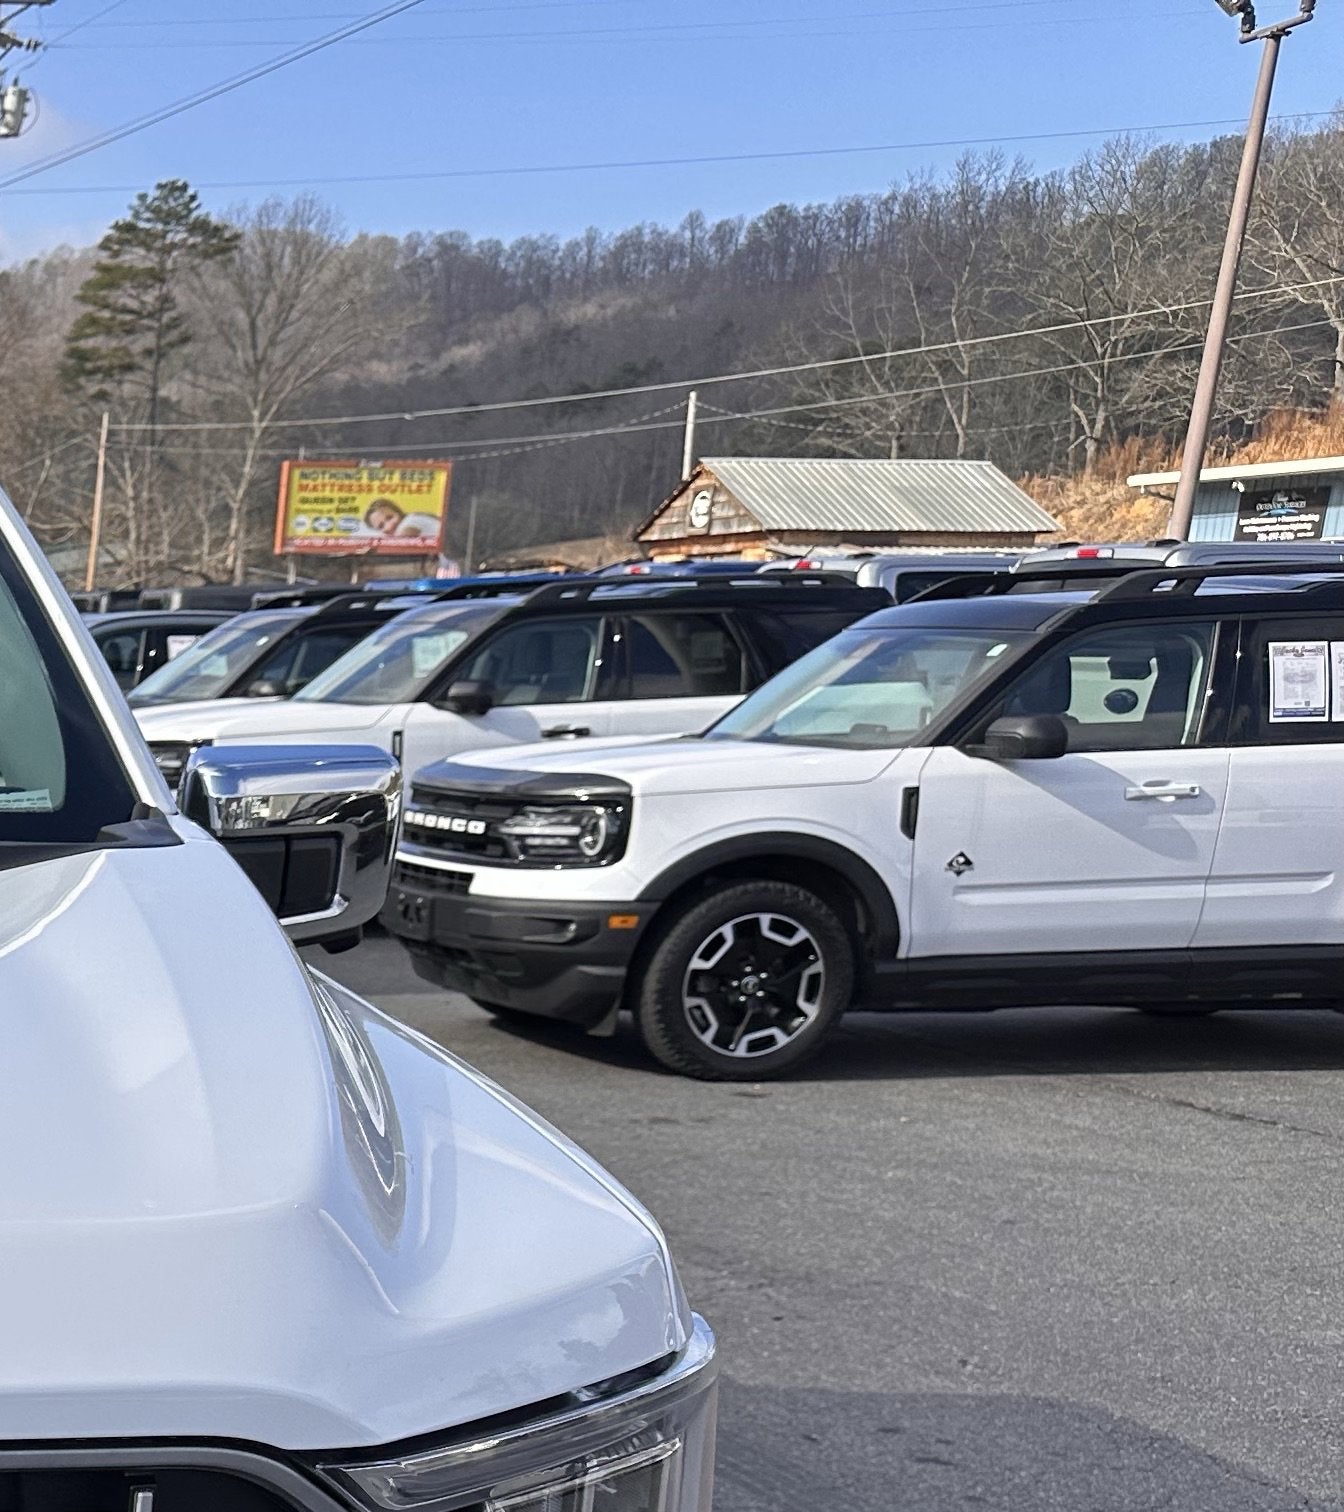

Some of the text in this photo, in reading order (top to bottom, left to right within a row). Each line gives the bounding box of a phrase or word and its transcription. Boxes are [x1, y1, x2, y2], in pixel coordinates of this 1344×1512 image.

[300, 469, 362, 480] NOTHING
[297, 482, 433, 494] MATTRESS OUTLET
[403, 810, 486, 834] BRONCO
